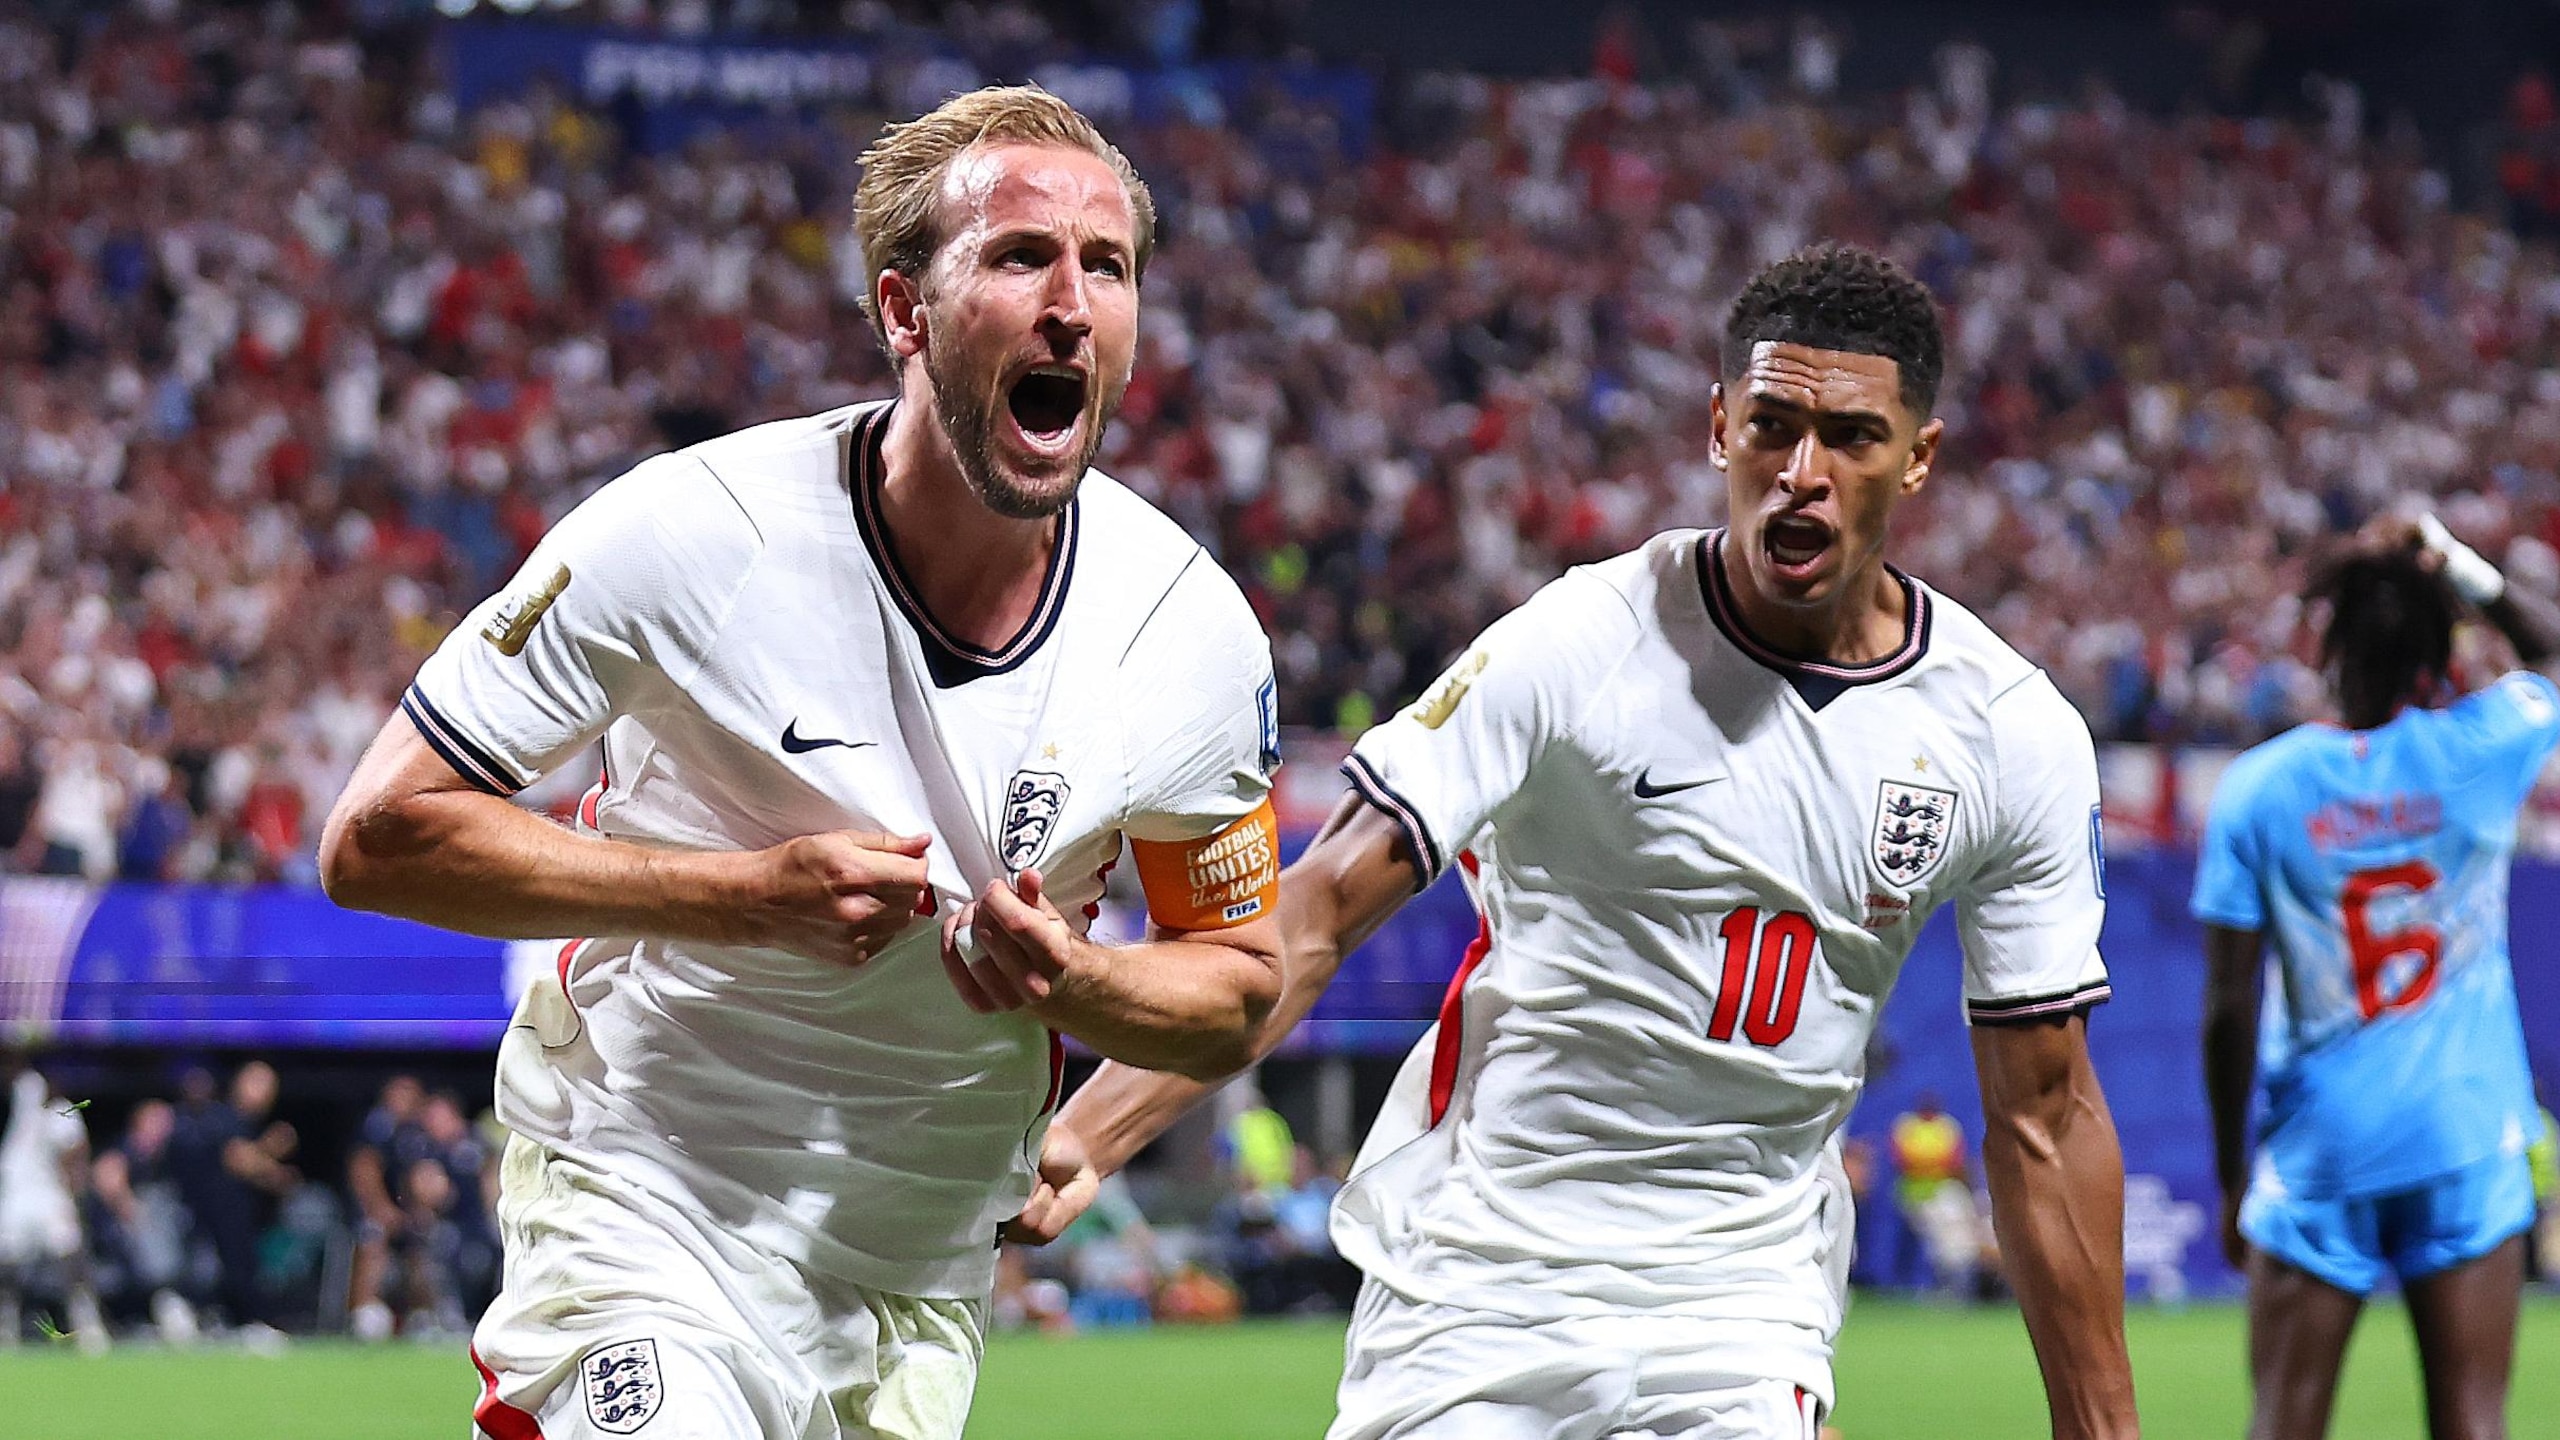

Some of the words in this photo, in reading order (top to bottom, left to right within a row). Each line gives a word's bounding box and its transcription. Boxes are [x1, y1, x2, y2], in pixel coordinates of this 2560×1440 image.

[1187, 819, 1265, 866] FOOTBALL
[1189, 838, 1271, 888] UNITES
[1230, 860, 1274, 900] World
[1227, 901, 1258, 918] FIFA
[2340, 861, 2441, 1022] 6
[1707, 906, 1818, 1047] 10
